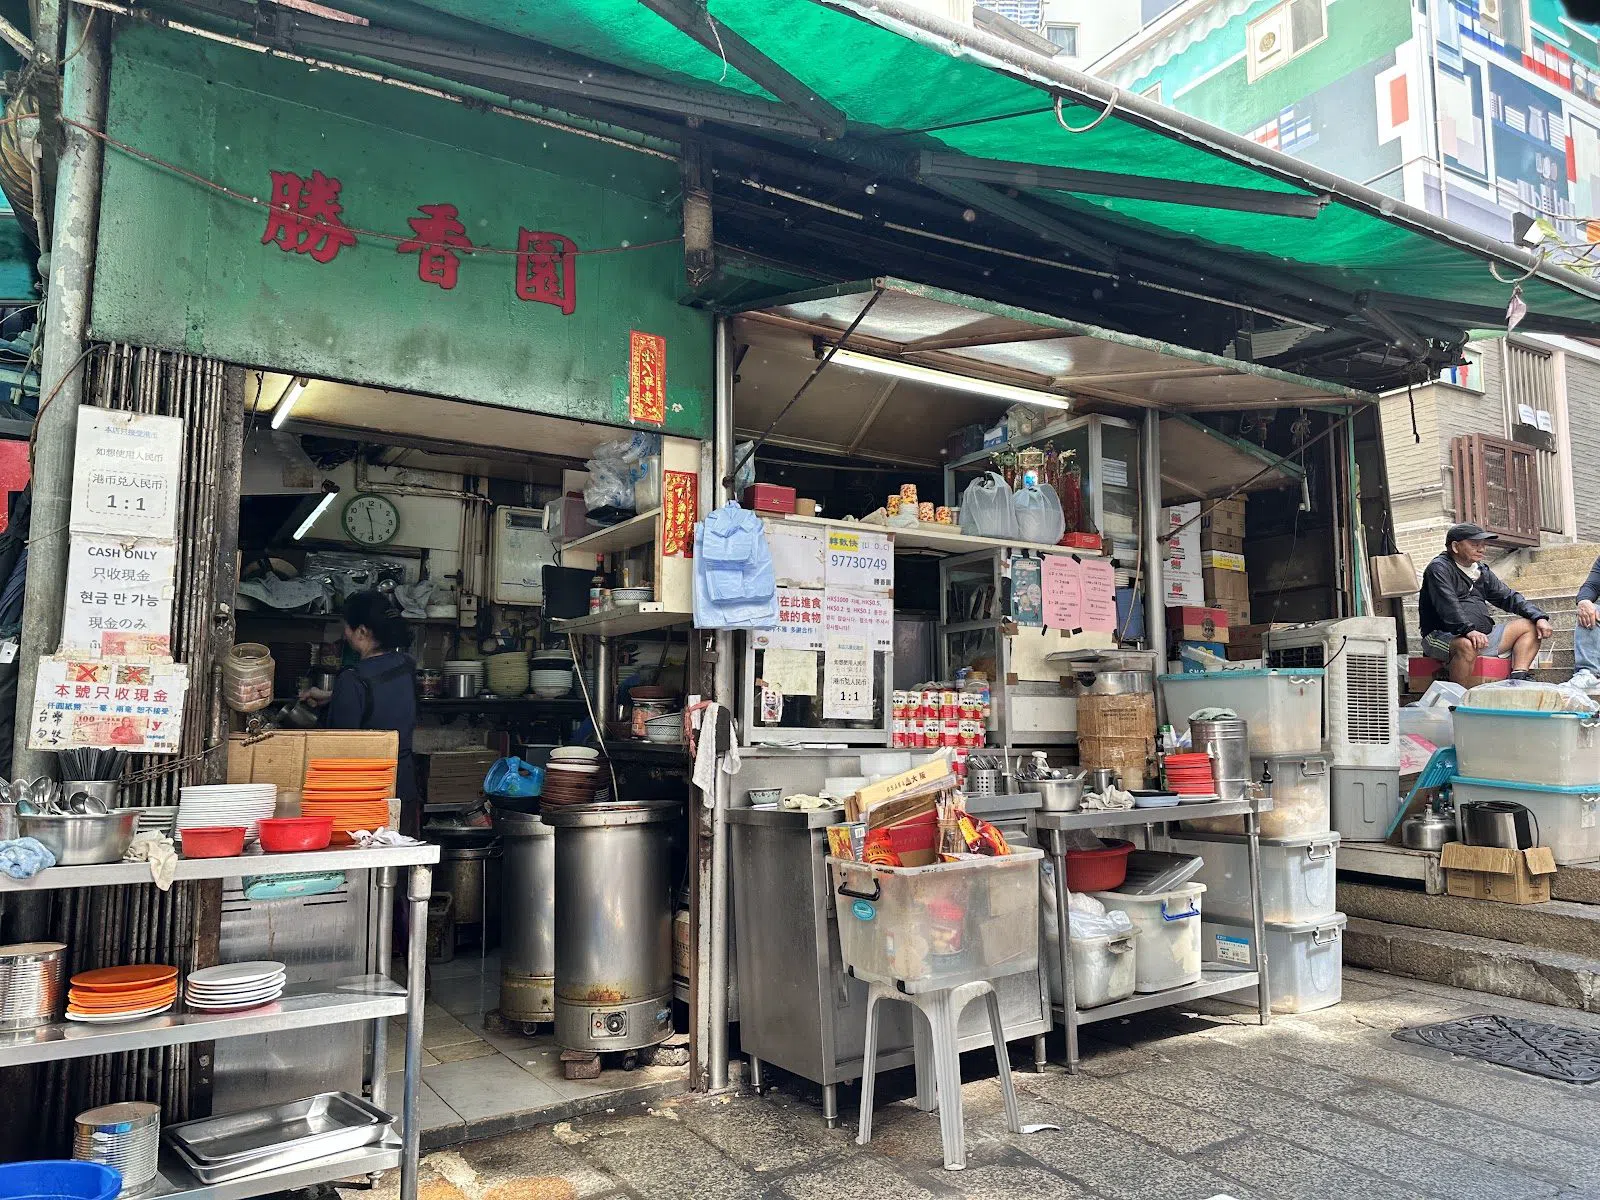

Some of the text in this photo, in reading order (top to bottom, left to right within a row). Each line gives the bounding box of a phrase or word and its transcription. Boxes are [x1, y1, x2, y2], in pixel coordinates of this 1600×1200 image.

[261, 167, 578, 316] 勝香園
[92, 473, 164, 491] 港币兑人民币
[88, 546, 158, 560] CASH ONLY
[832, 554, 888, 571] 97730749
[92, 567, 151, 582] 只收現金
[80, 591, 109, 604] 현금
[132, 593, 159, 607] 가능
[777, 596, 821, 609] 在此進食
[88, 616, 147, 630] 現金のみ
[54, 684, 168, 702] 本號只收現金
[841, 691, 859, 702] 1:1
